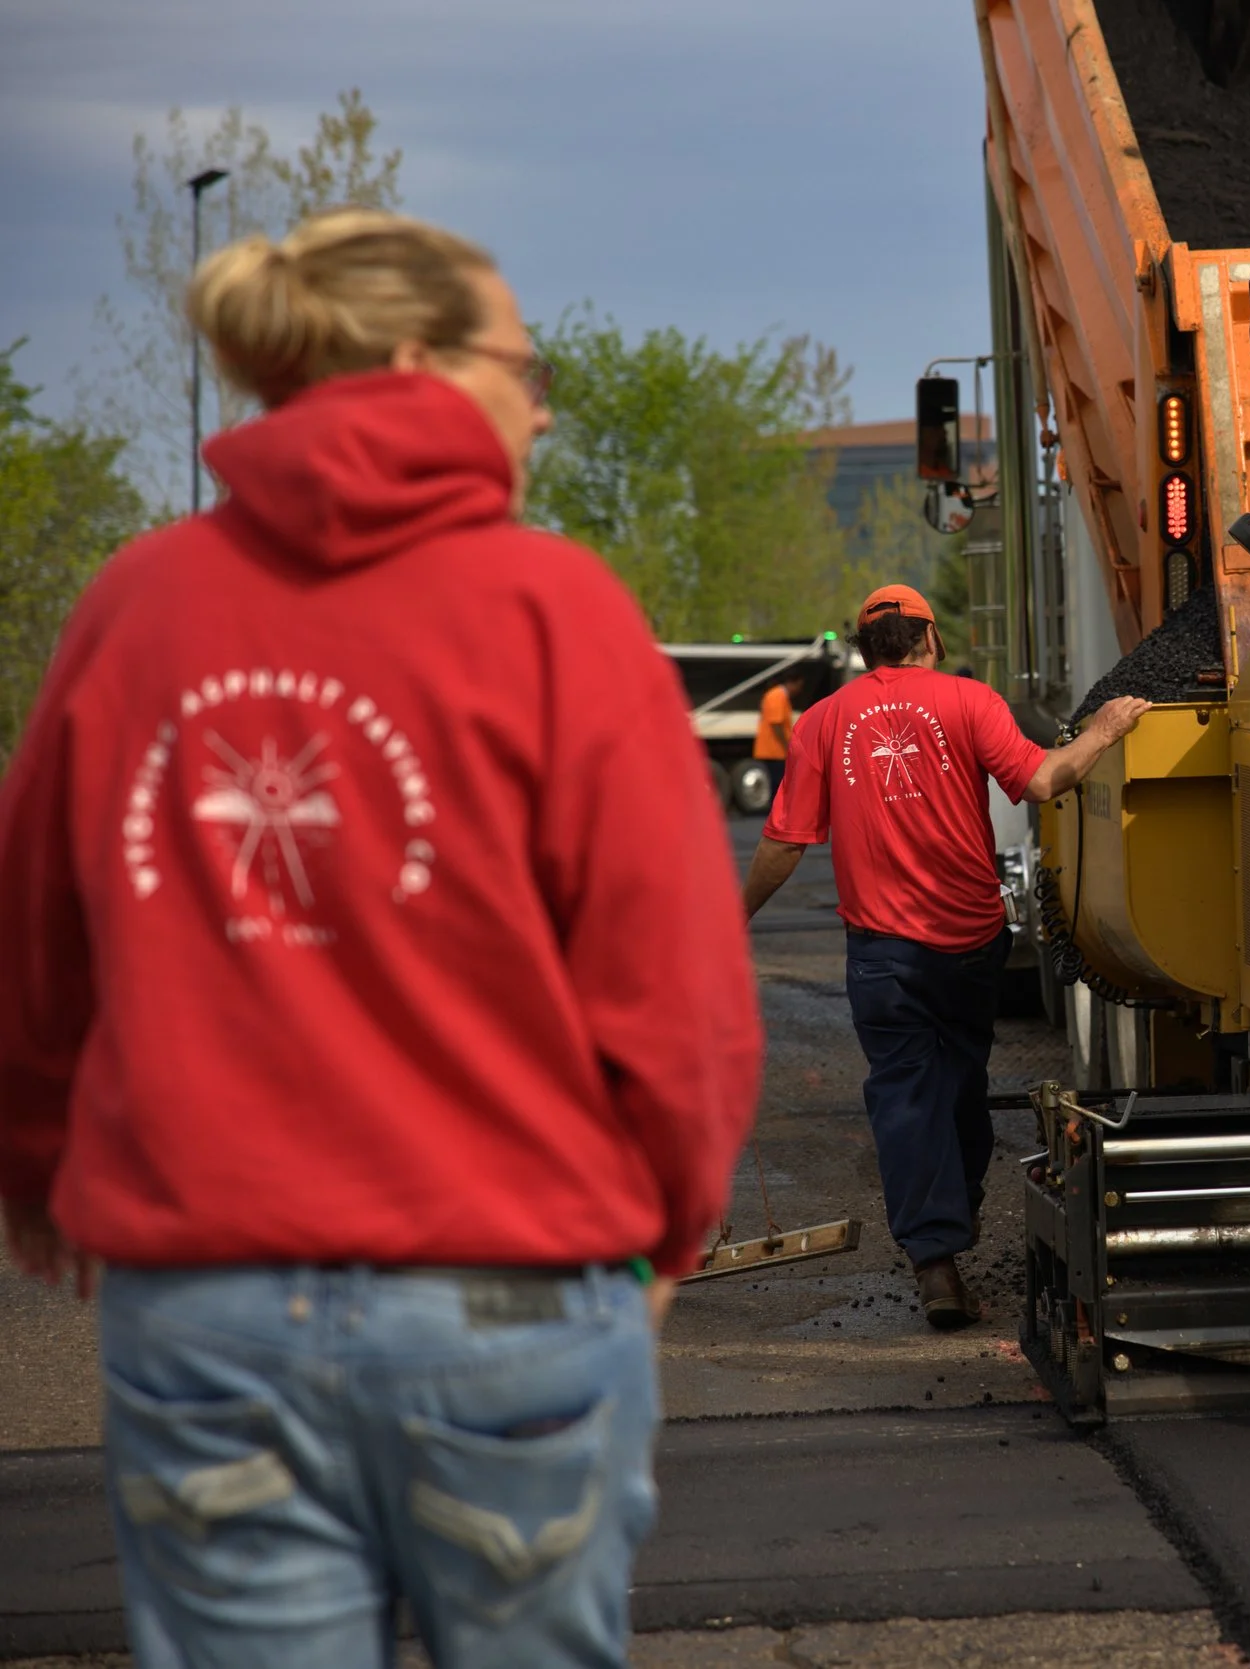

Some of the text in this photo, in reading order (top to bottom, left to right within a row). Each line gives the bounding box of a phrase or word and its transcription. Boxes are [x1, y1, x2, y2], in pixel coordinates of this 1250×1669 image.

[843, 702, 950, 786] WYOMING ASPHALT PAVING CO.
